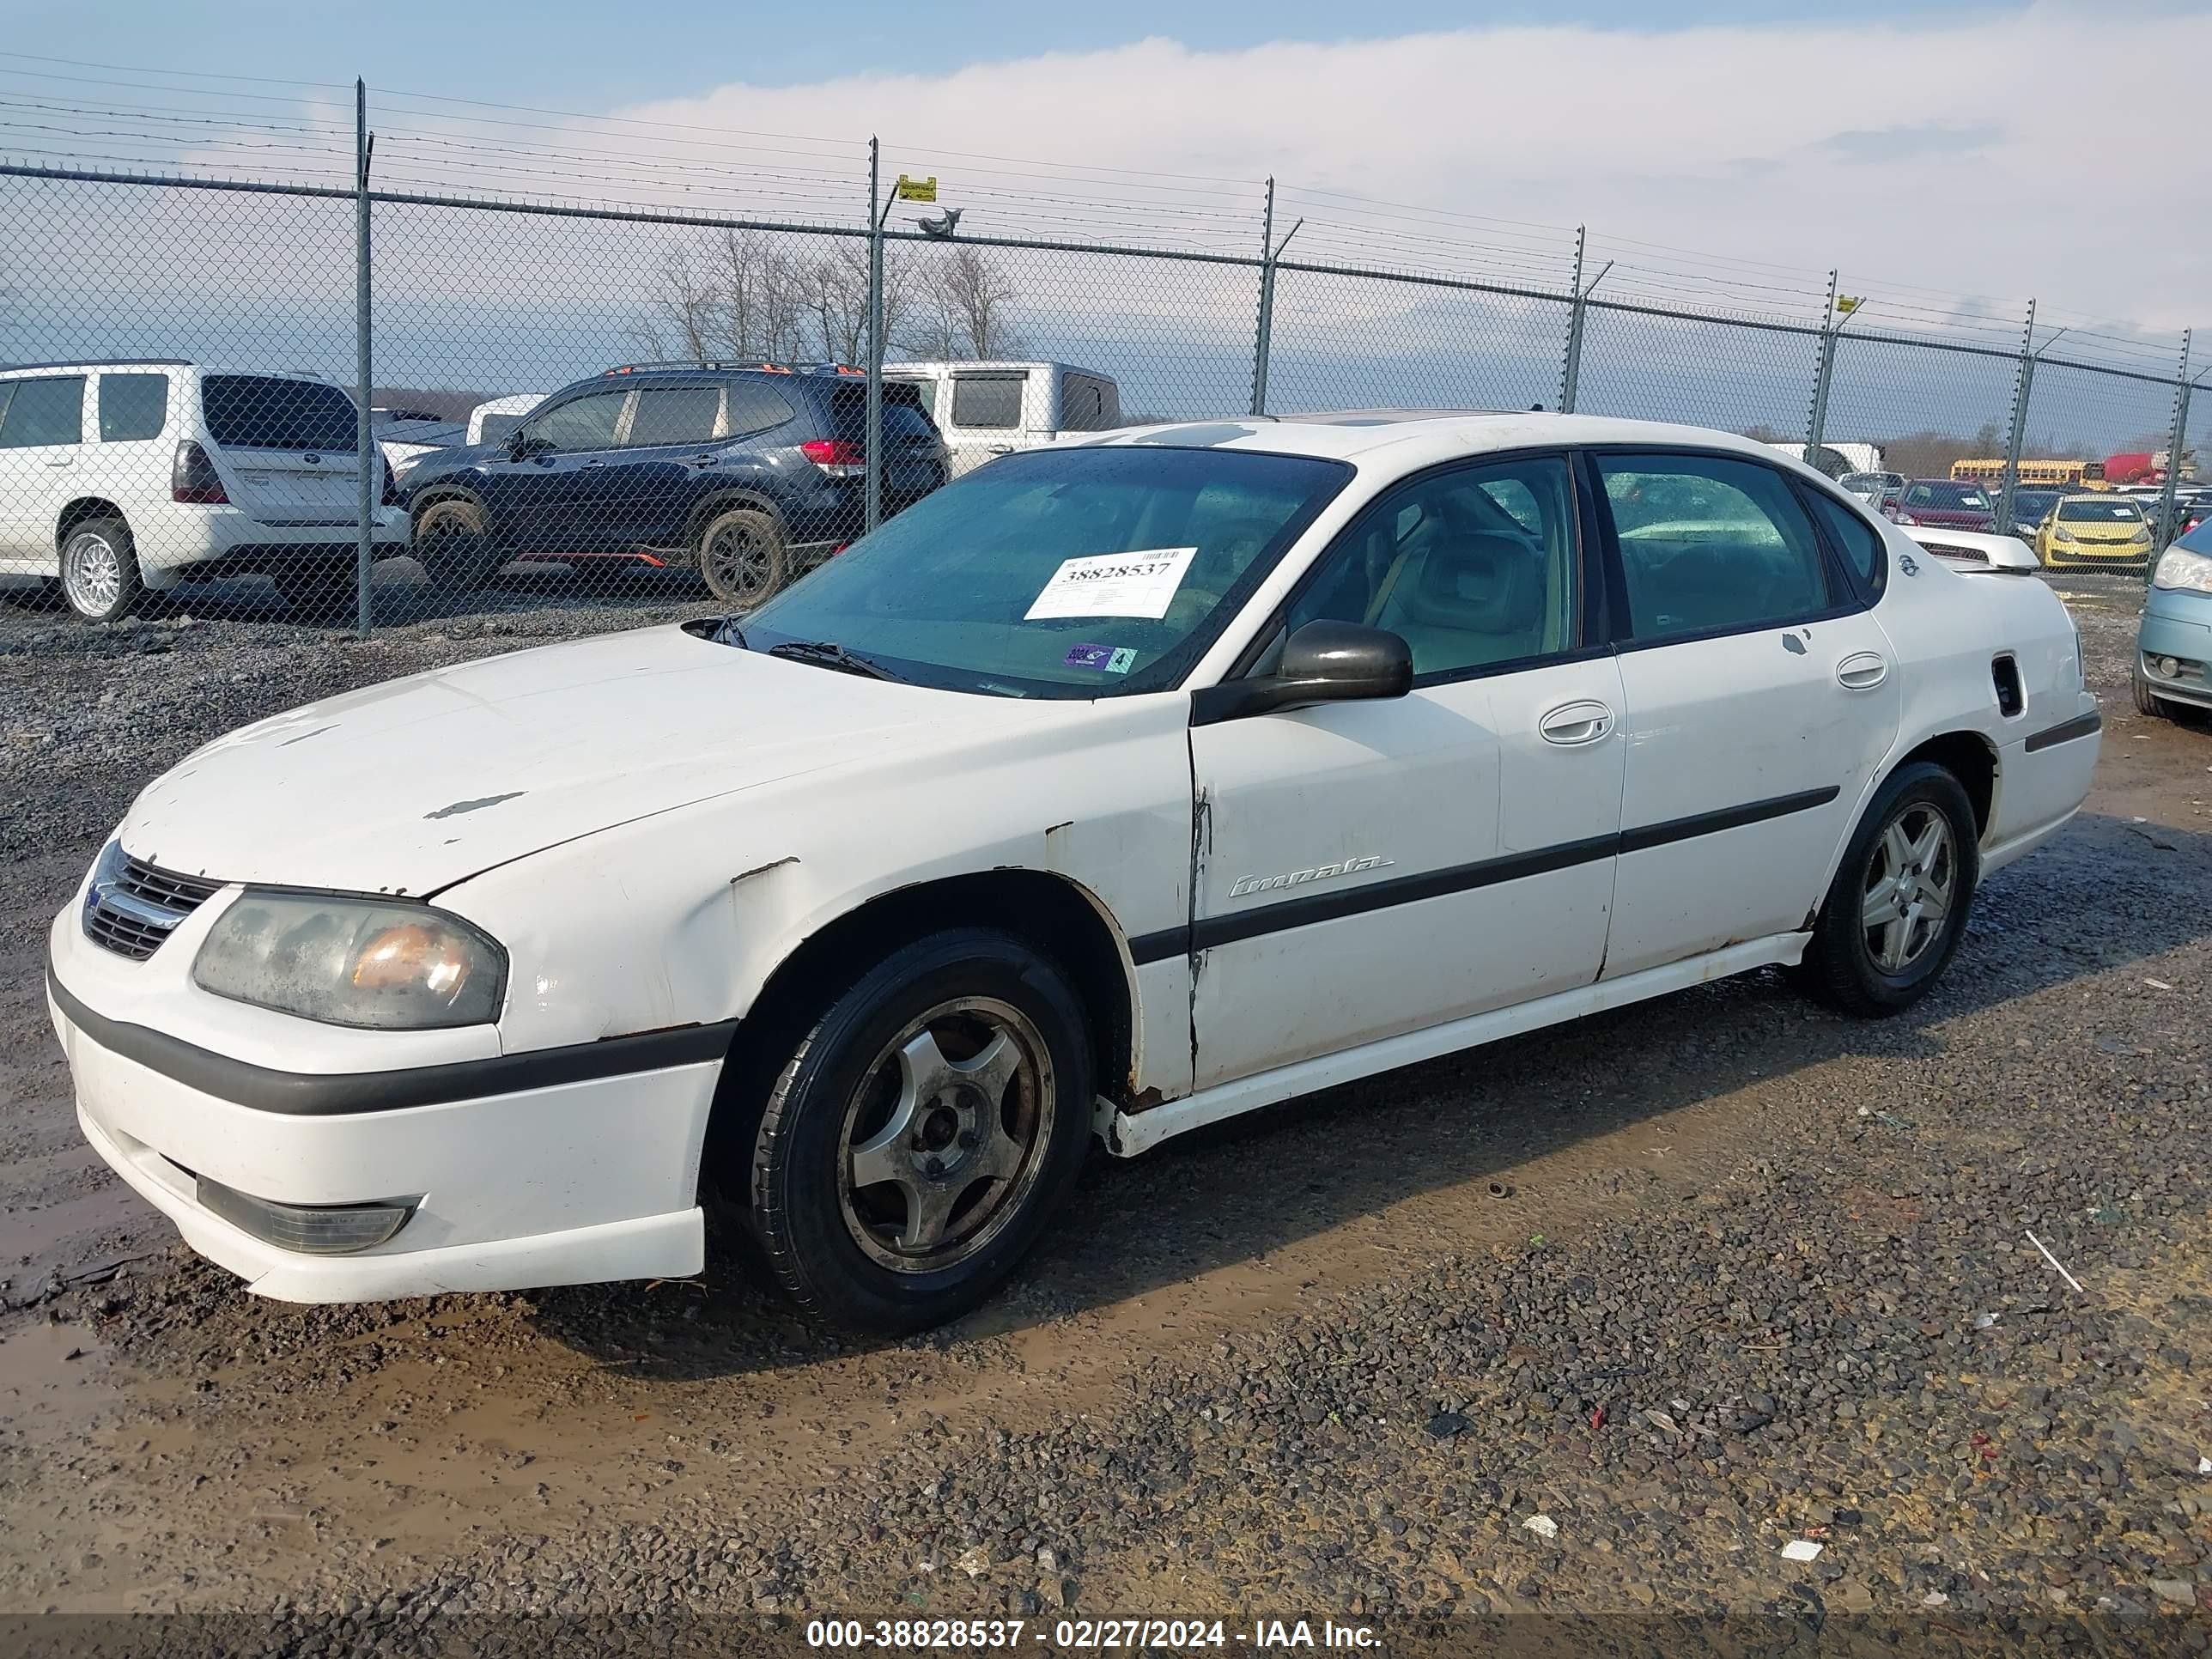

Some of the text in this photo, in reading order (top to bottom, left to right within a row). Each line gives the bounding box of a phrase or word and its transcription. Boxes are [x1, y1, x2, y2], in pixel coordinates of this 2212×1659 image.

[1062, 562, 1171, 583] 38828537
[1115, 653, 1126, 666] 4
[1228, 855, 1395, 898] Impala
